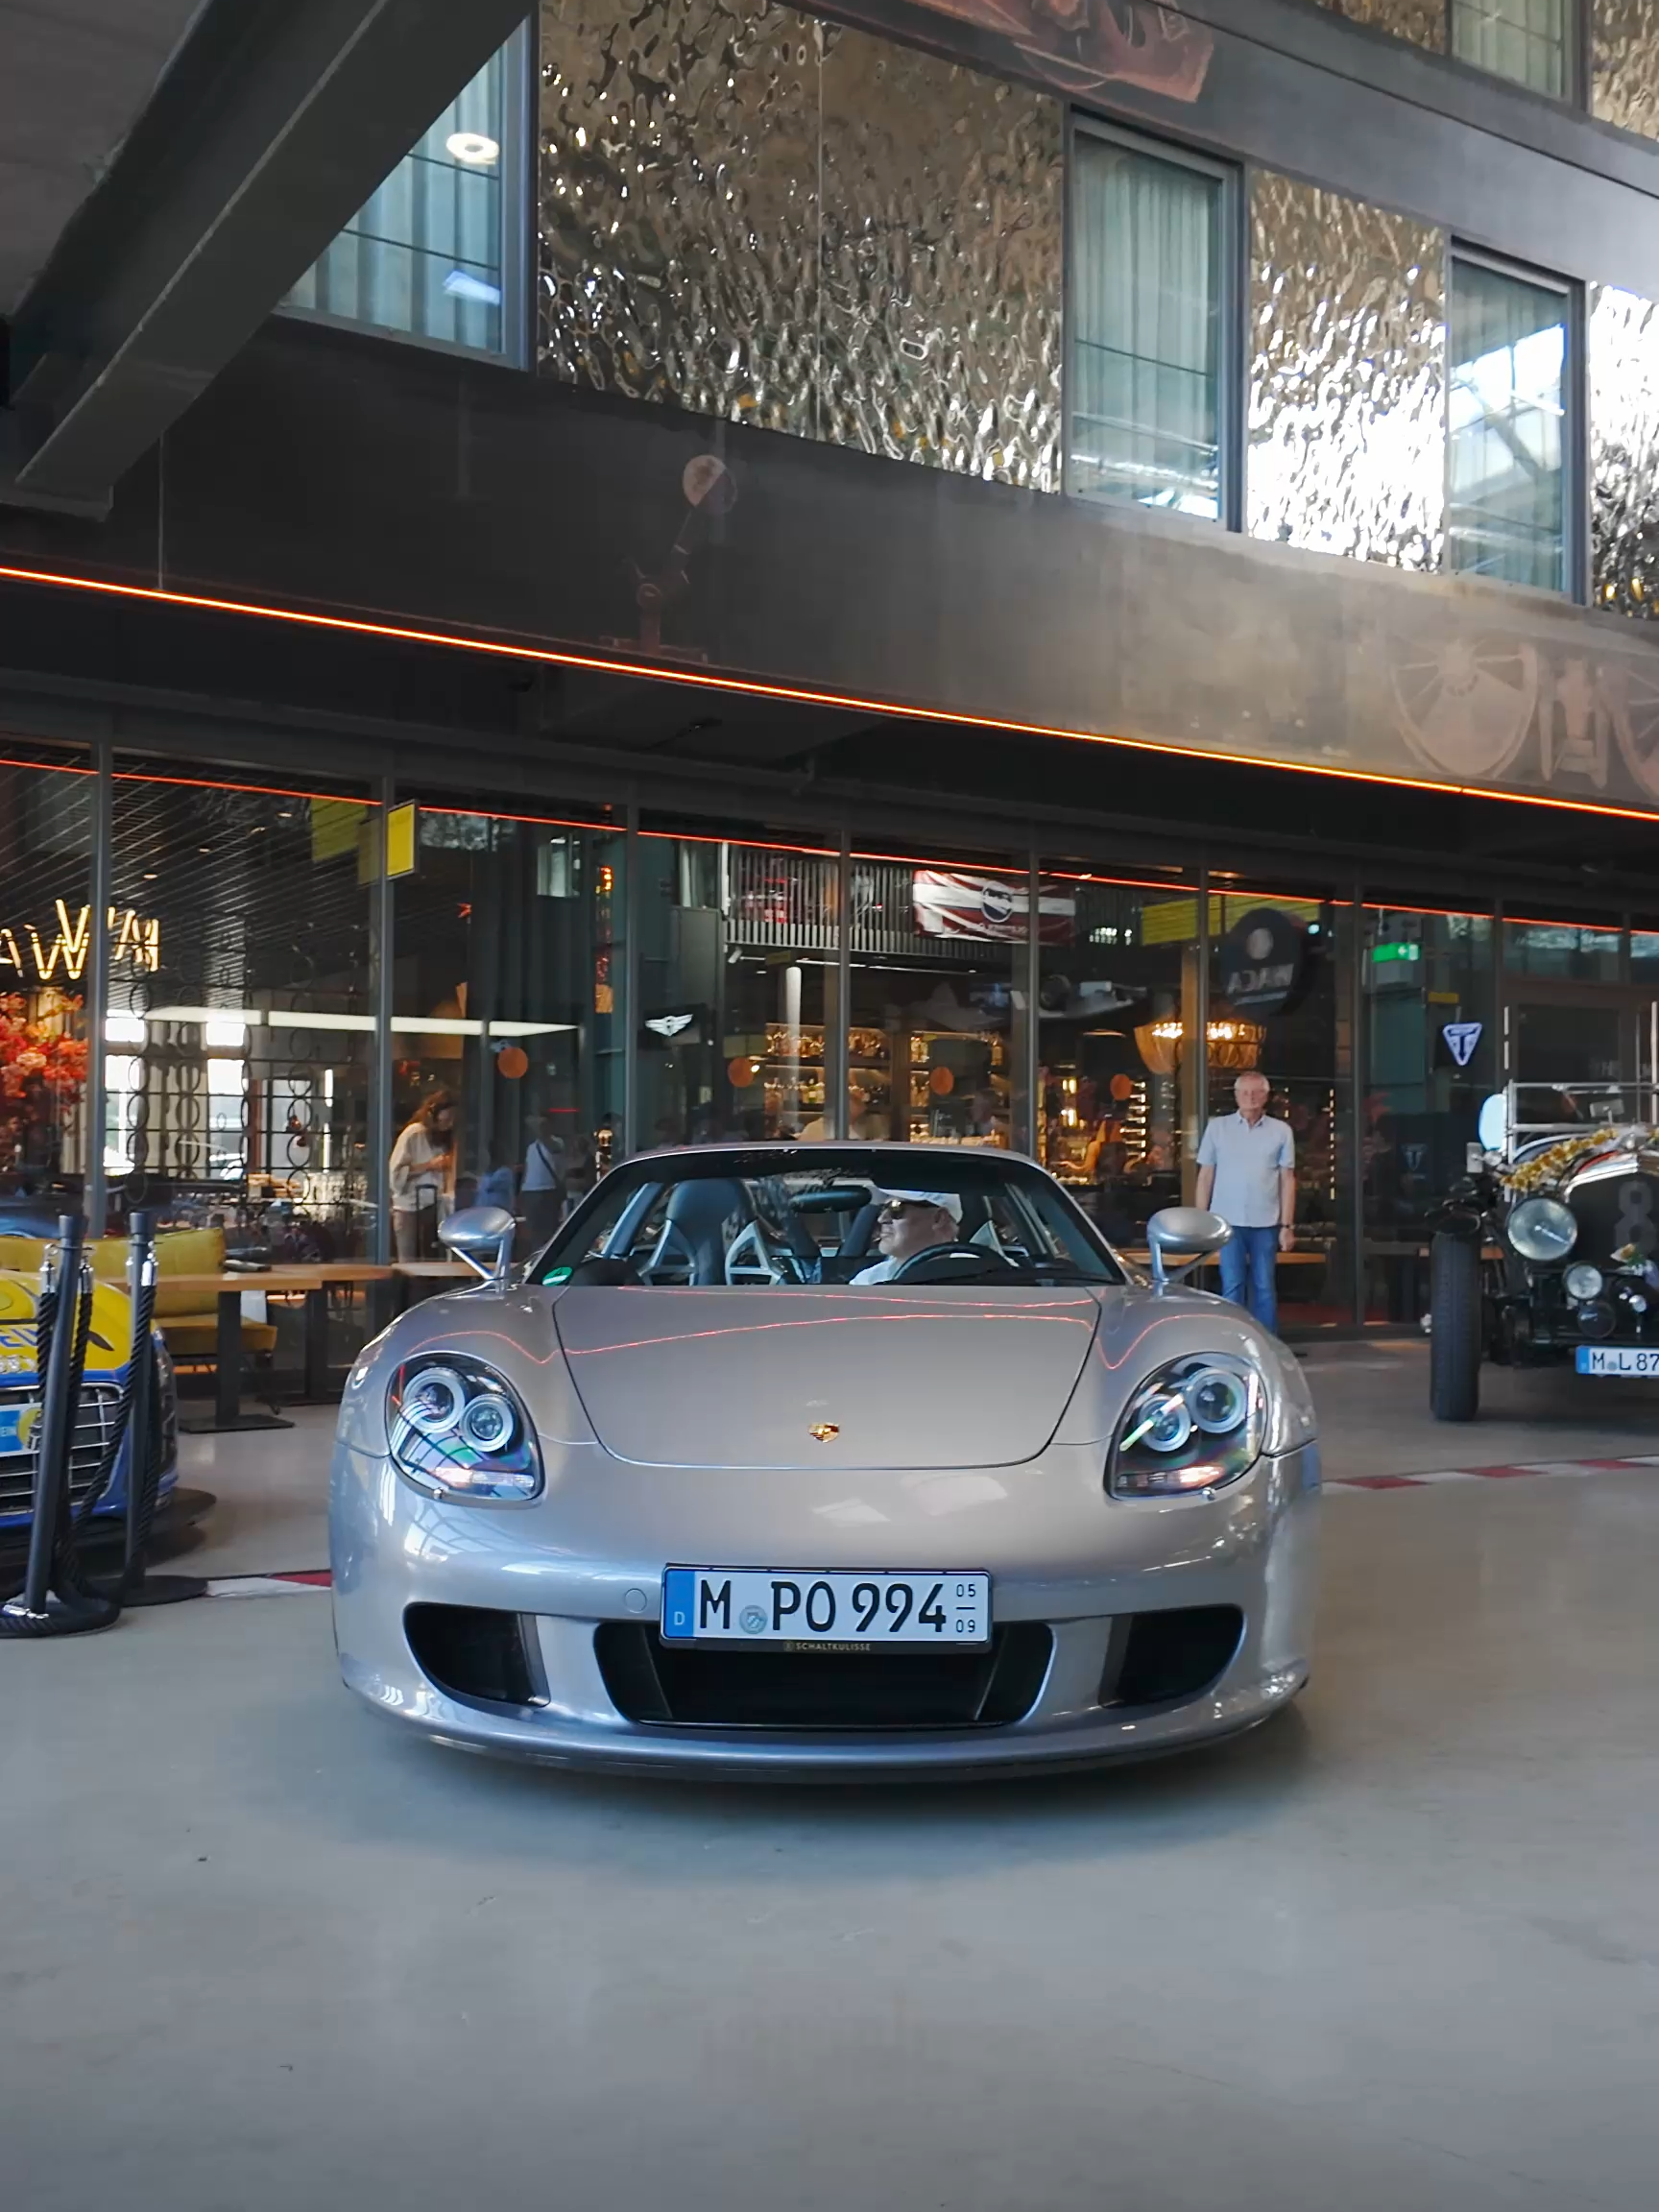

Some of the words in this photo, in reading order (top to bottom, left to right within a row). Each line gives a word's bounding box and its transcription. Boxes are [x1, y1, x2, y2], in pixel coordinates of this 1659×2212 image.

[1592, 1352, 1605, 1371] M
[1619, 1352, 1631, 1371] L
[955, 1583, 976, 1598] 05
[700, 1579, 732, 1630] M
[771, 1580, 836, 1632] PO
[852, 1582, 947, 1633] 994
[674, 1611, 685, 1625] D
[955, 1619, 976, 1633] 09
[795, 1642, 872, 1651] SCHALTKULISSE
